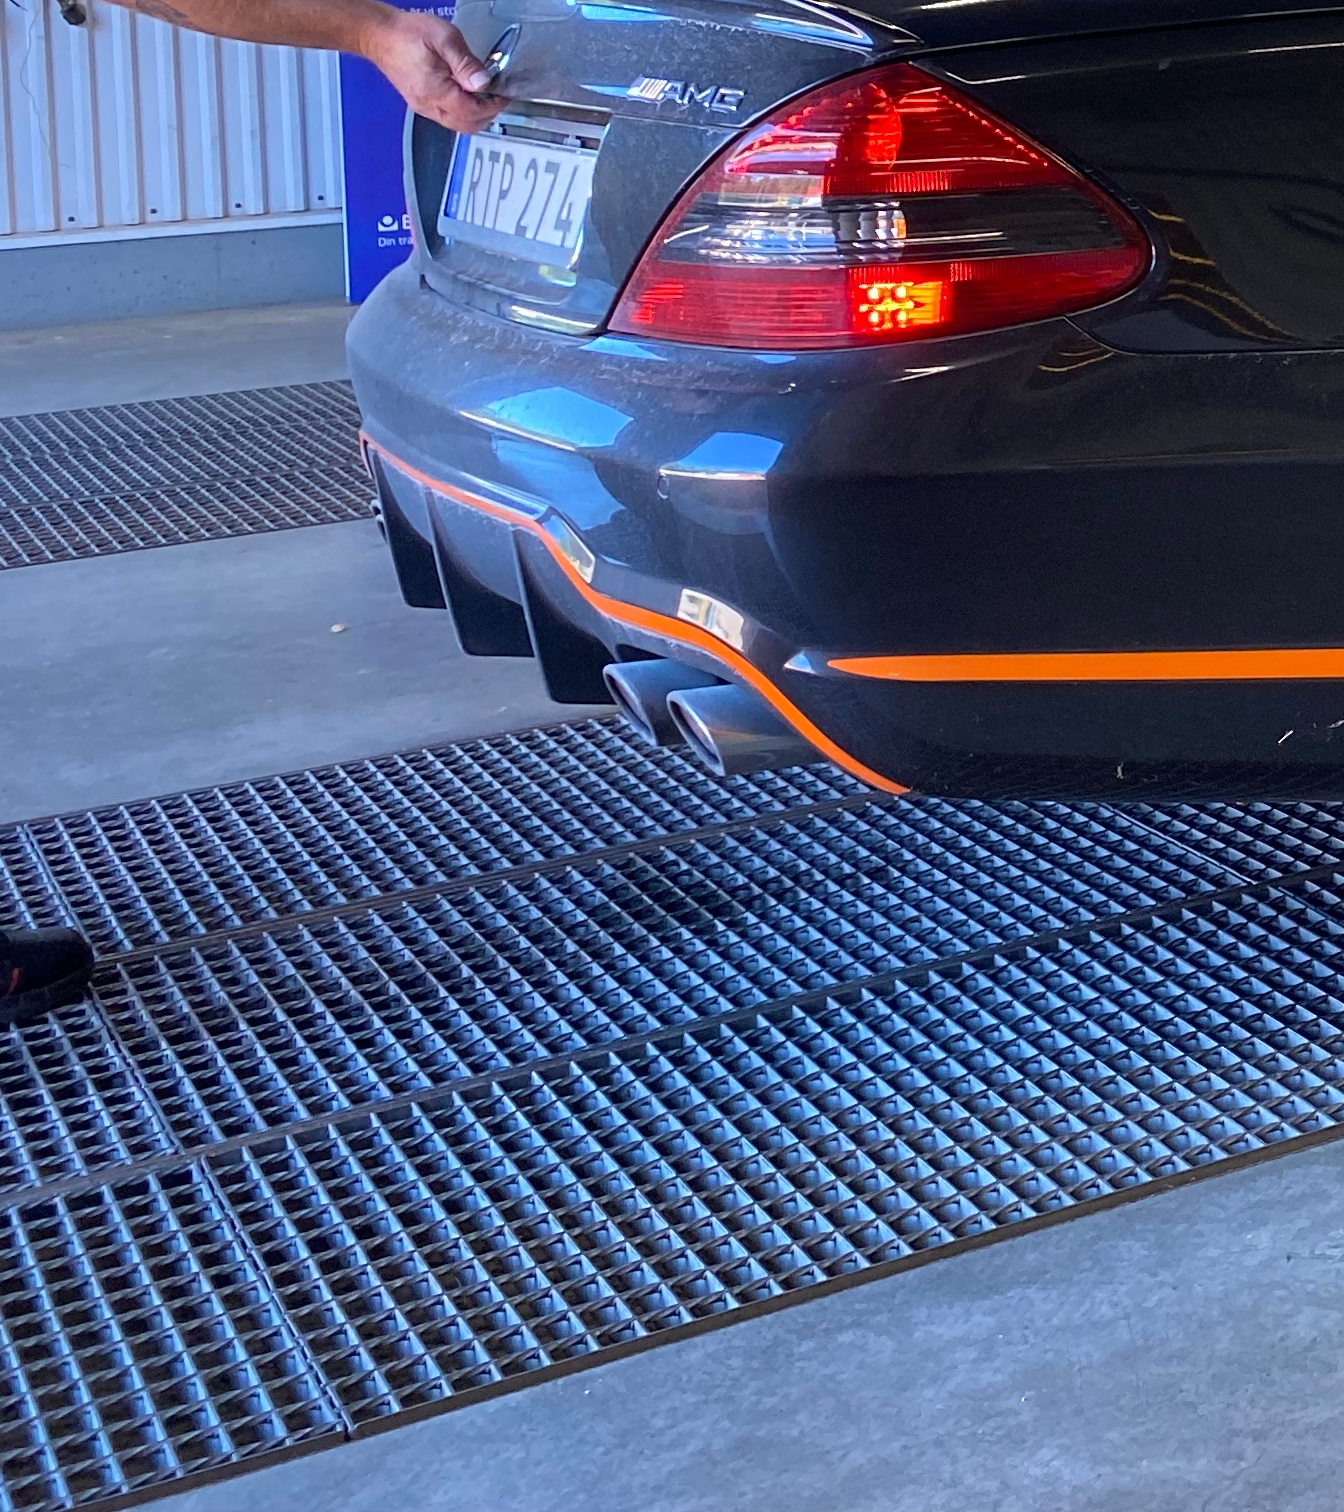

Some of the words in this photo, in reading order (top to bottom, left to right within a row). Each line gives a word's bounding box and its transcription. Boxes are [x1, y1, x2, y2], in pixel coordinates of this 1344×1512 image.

[462, 147, 516, 231] RTP
[514, 158, 580, 248] 274
[378, 237, 396, 247] Din
